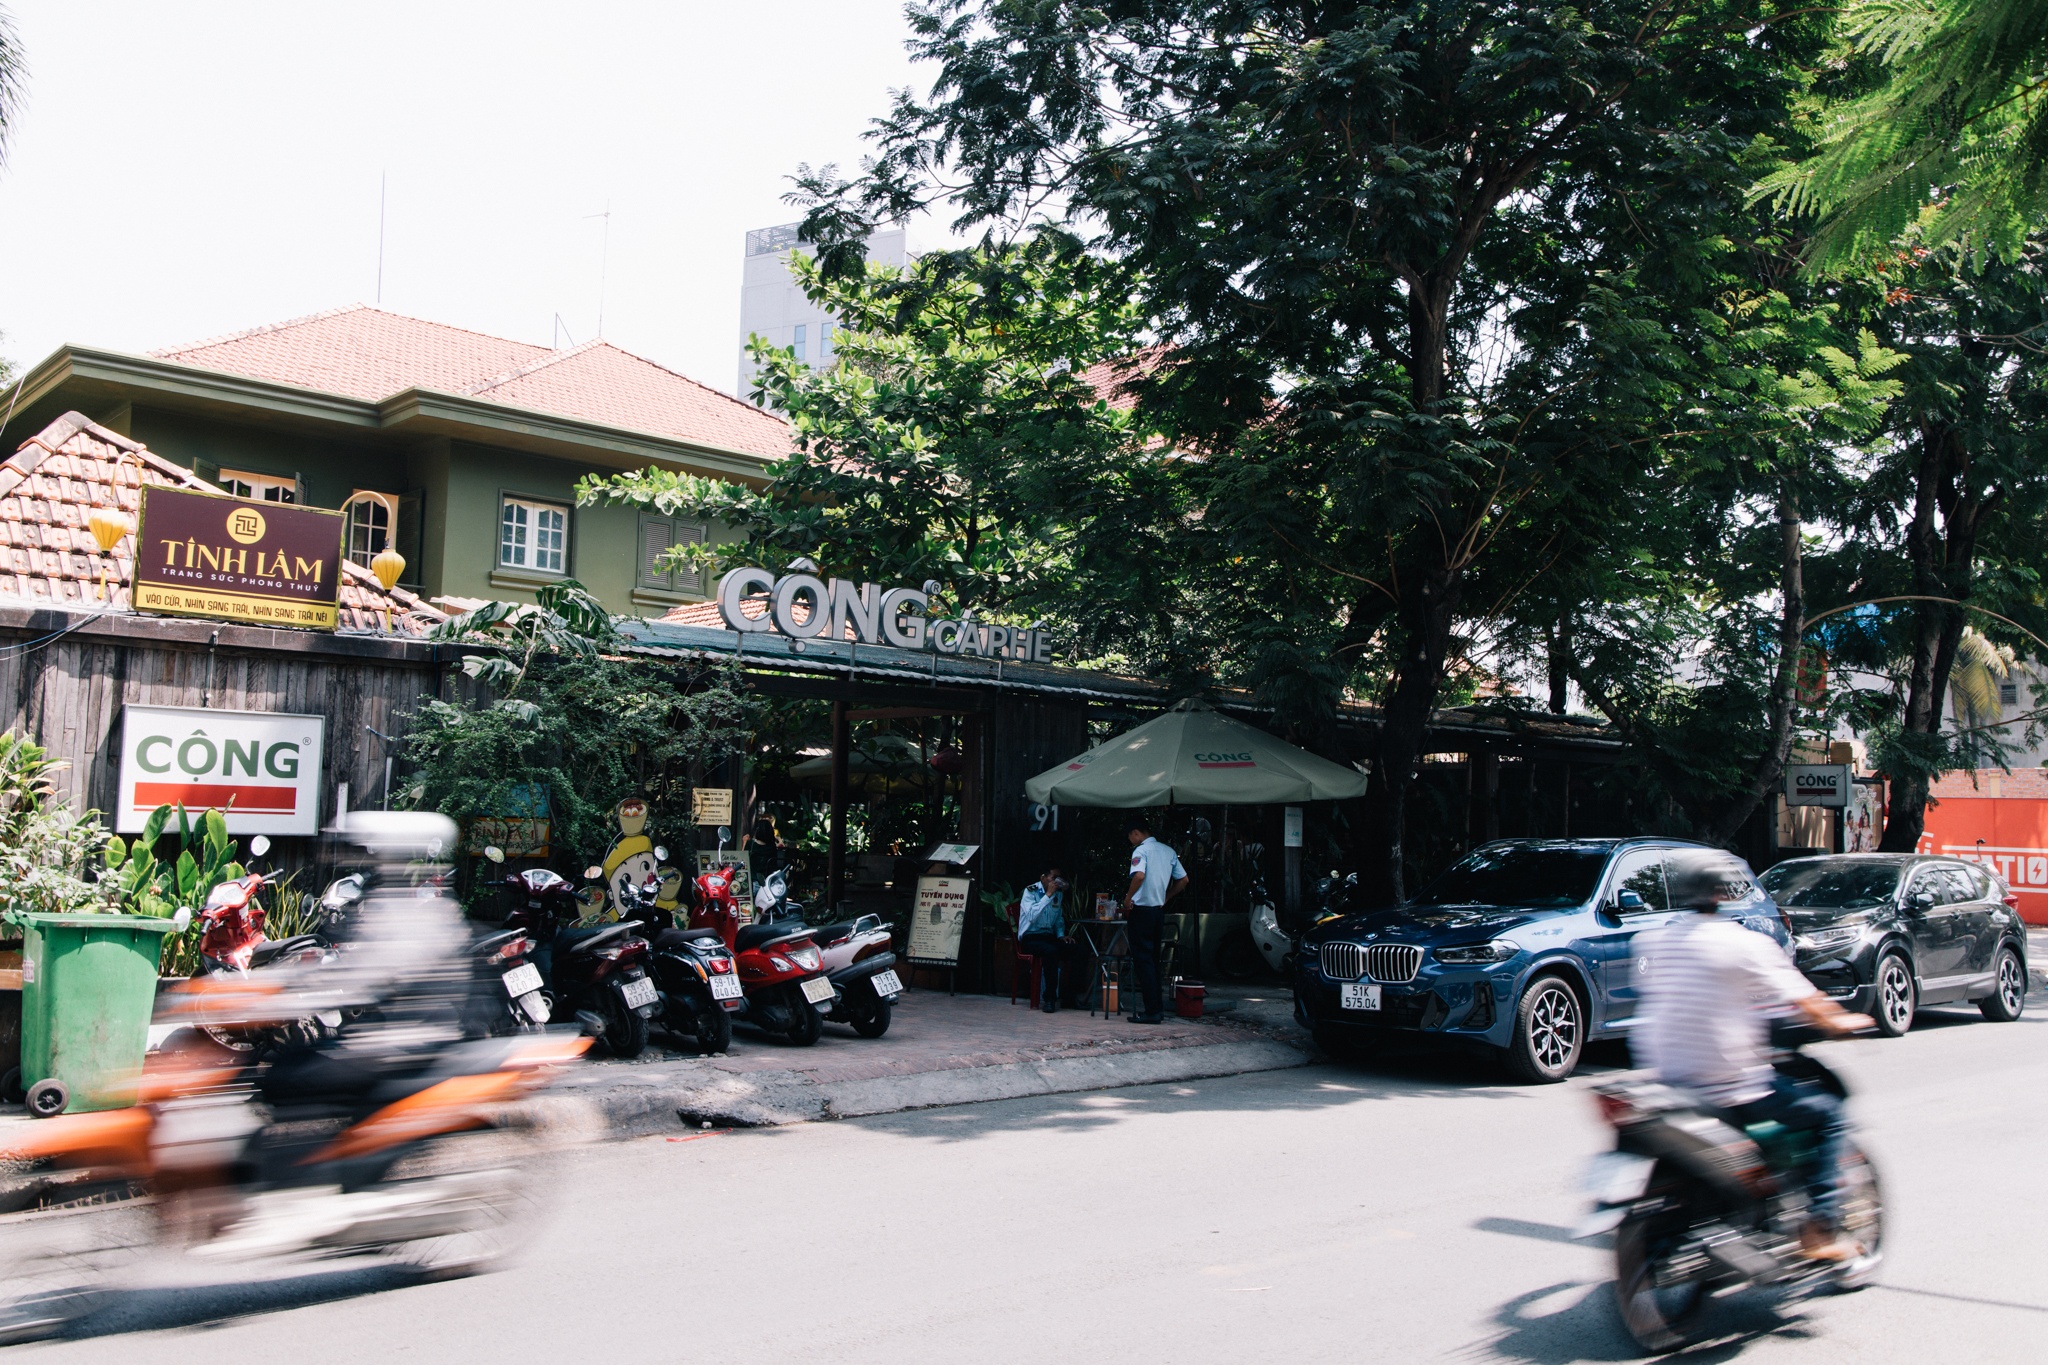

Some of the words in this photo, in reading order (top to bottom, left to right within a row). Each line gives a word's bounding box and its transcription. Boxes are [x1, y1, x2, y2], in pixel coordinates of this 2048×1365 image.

[162, 567, 203, 579] TRANG
[241, 577, 283, 588] PHONG
[207, 600, 229, 612] SANG
[275, 608, 295, 619] SANG
[1034, 804, 1058, 831] 91
[1353, 986, 1369, 997] 51K
[1346, 997, 1376, 1009] 575.04
